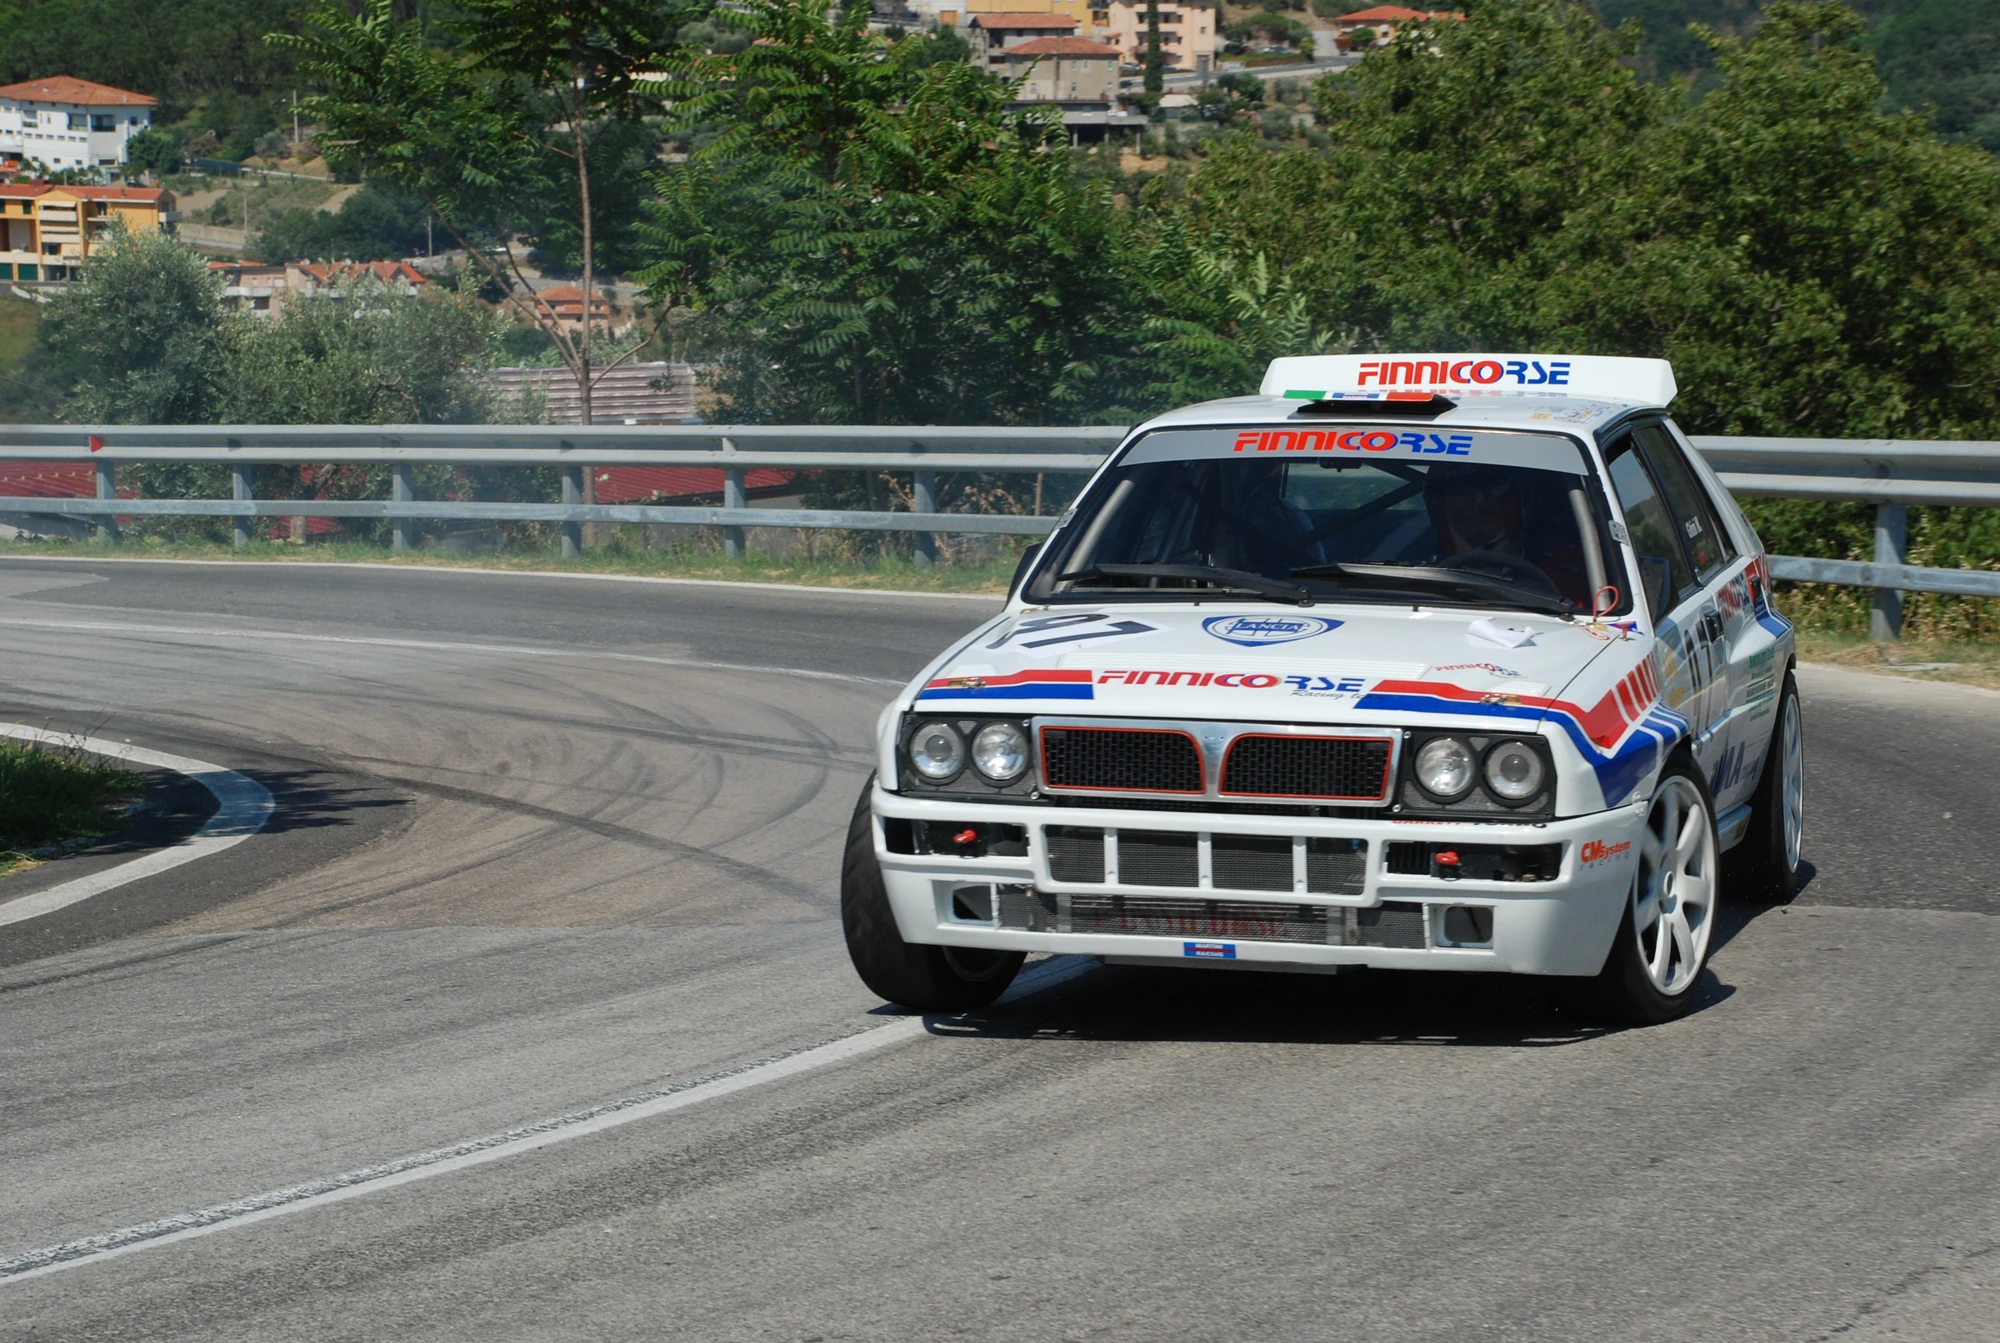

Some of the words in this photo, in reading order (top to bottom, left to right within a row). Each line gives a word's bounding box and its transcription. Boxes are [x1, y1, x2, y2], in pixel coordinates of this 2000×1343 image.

[1358, 361, 1571, 386] FINNICORSE
[1233, 431, 1473, 455] FINNICORSE
[1236, 622, 1300, 631] LANCIA
[1097, 670, 1366, 692] FINNICORSE
